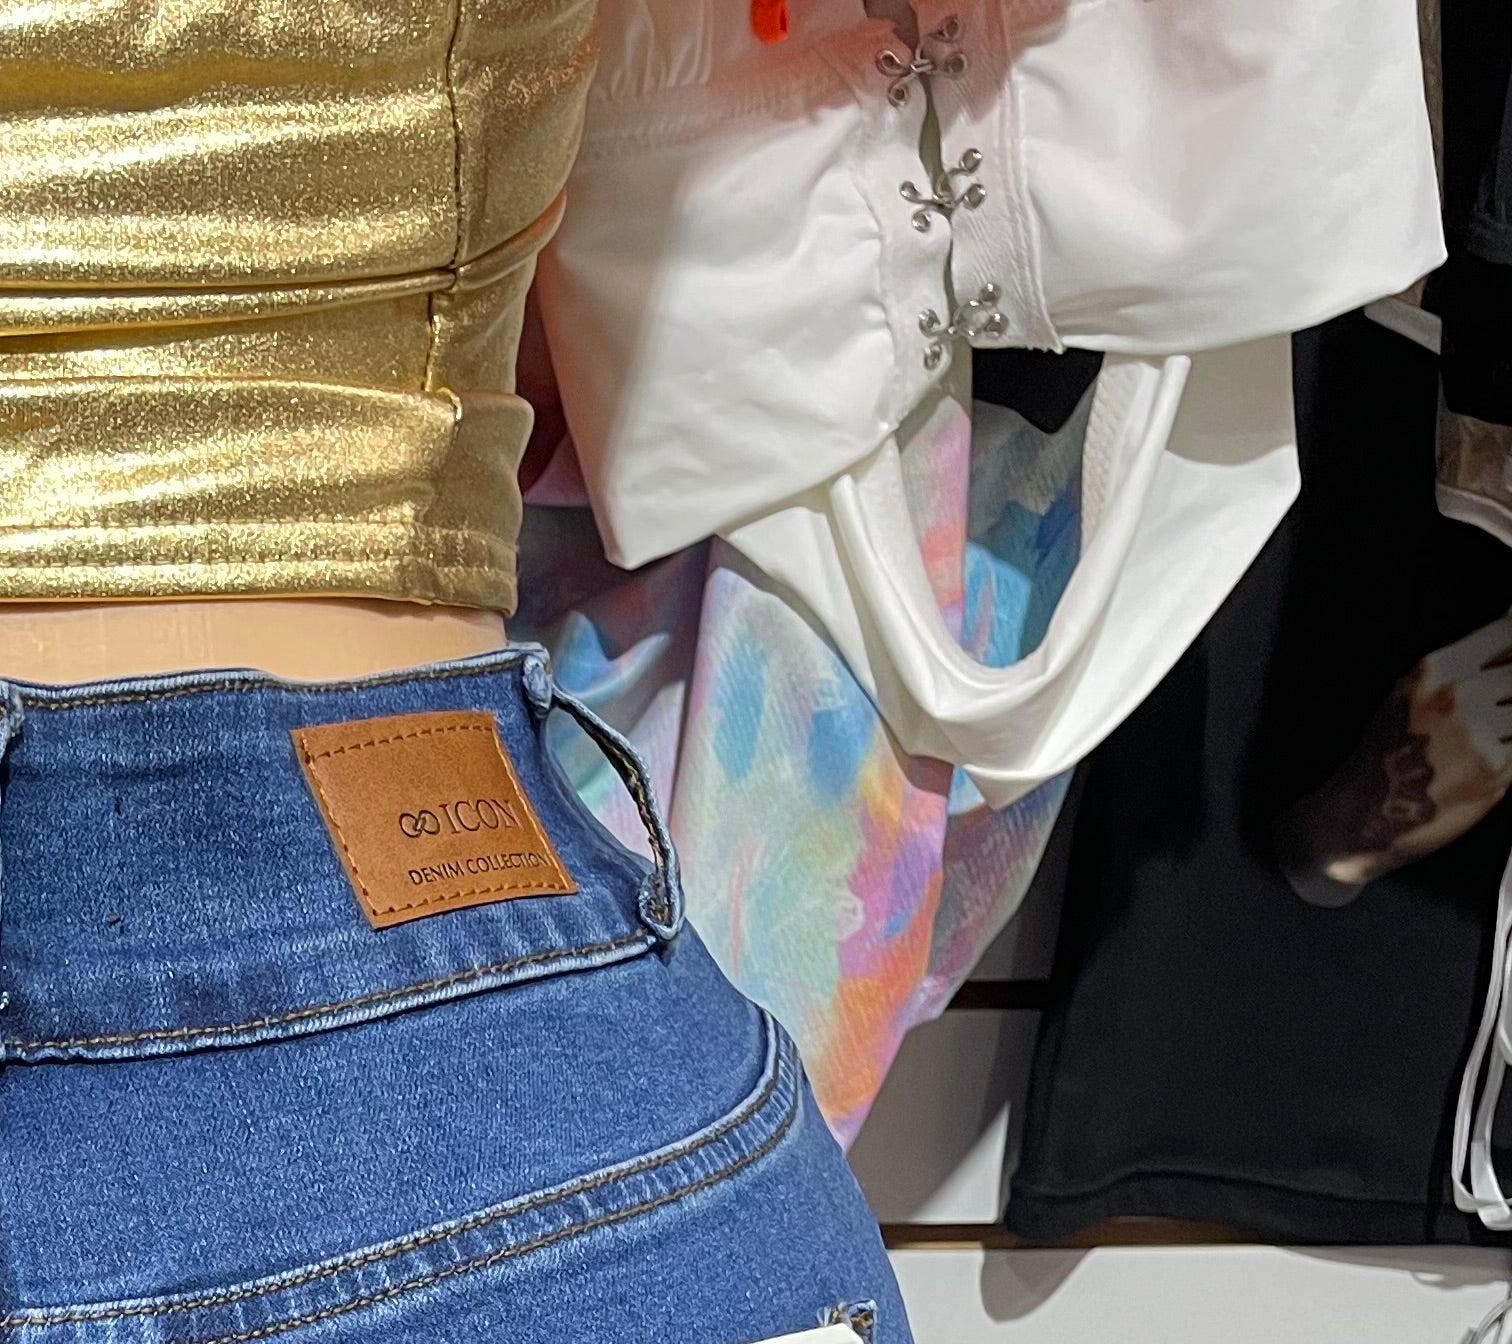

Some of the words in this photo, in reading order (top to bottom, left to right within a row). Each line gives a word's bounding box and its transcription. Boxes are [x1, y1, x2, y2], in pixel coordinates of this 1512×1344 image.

[439, 799, 524, 834] ICON
[408, 861, 465, 885] DENIM
[466, 852, 551, 874] COLLECTION
